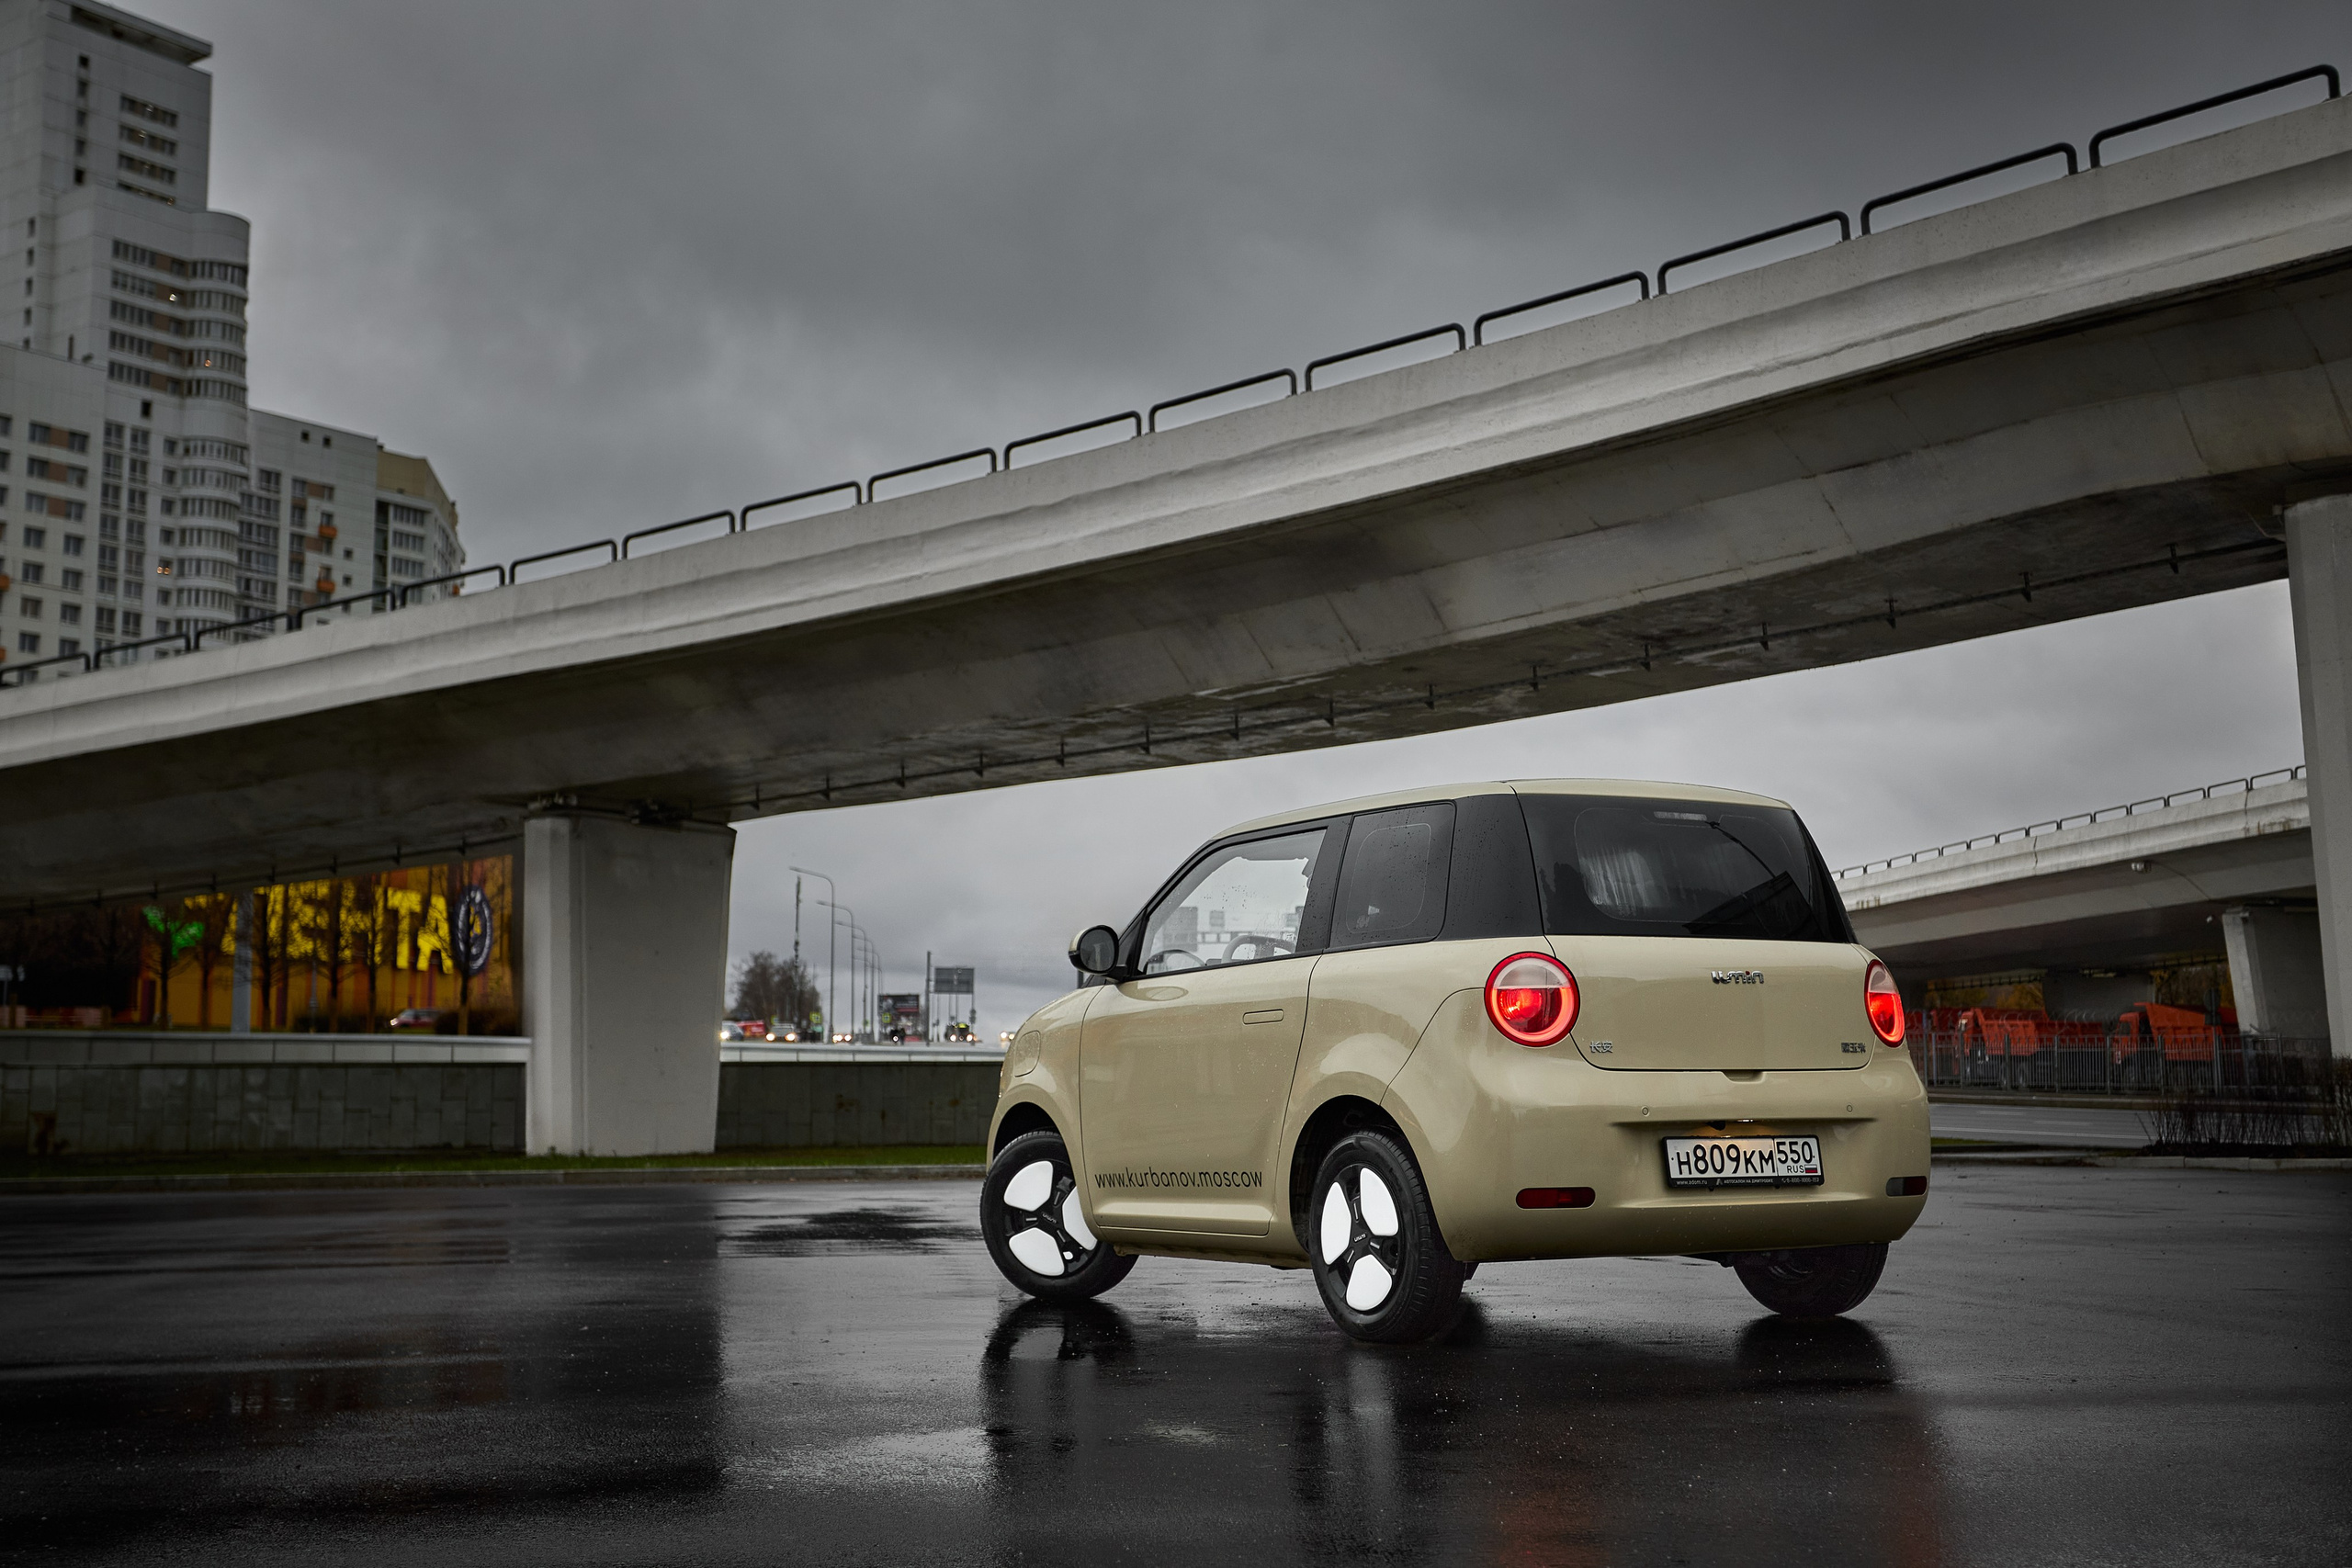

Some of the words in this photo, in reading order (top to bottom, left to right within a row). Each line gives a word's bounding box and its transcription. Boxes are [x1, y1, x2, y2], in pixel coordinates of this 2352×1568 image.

[1589, 1041, 1612, 1053] 长安
[1776, 1141, 1814, 1164] 550
[1094, 1167, 1262, 1189] www.kurbanov.moscow
[1787, 1165, 1804, 1174] RUS
